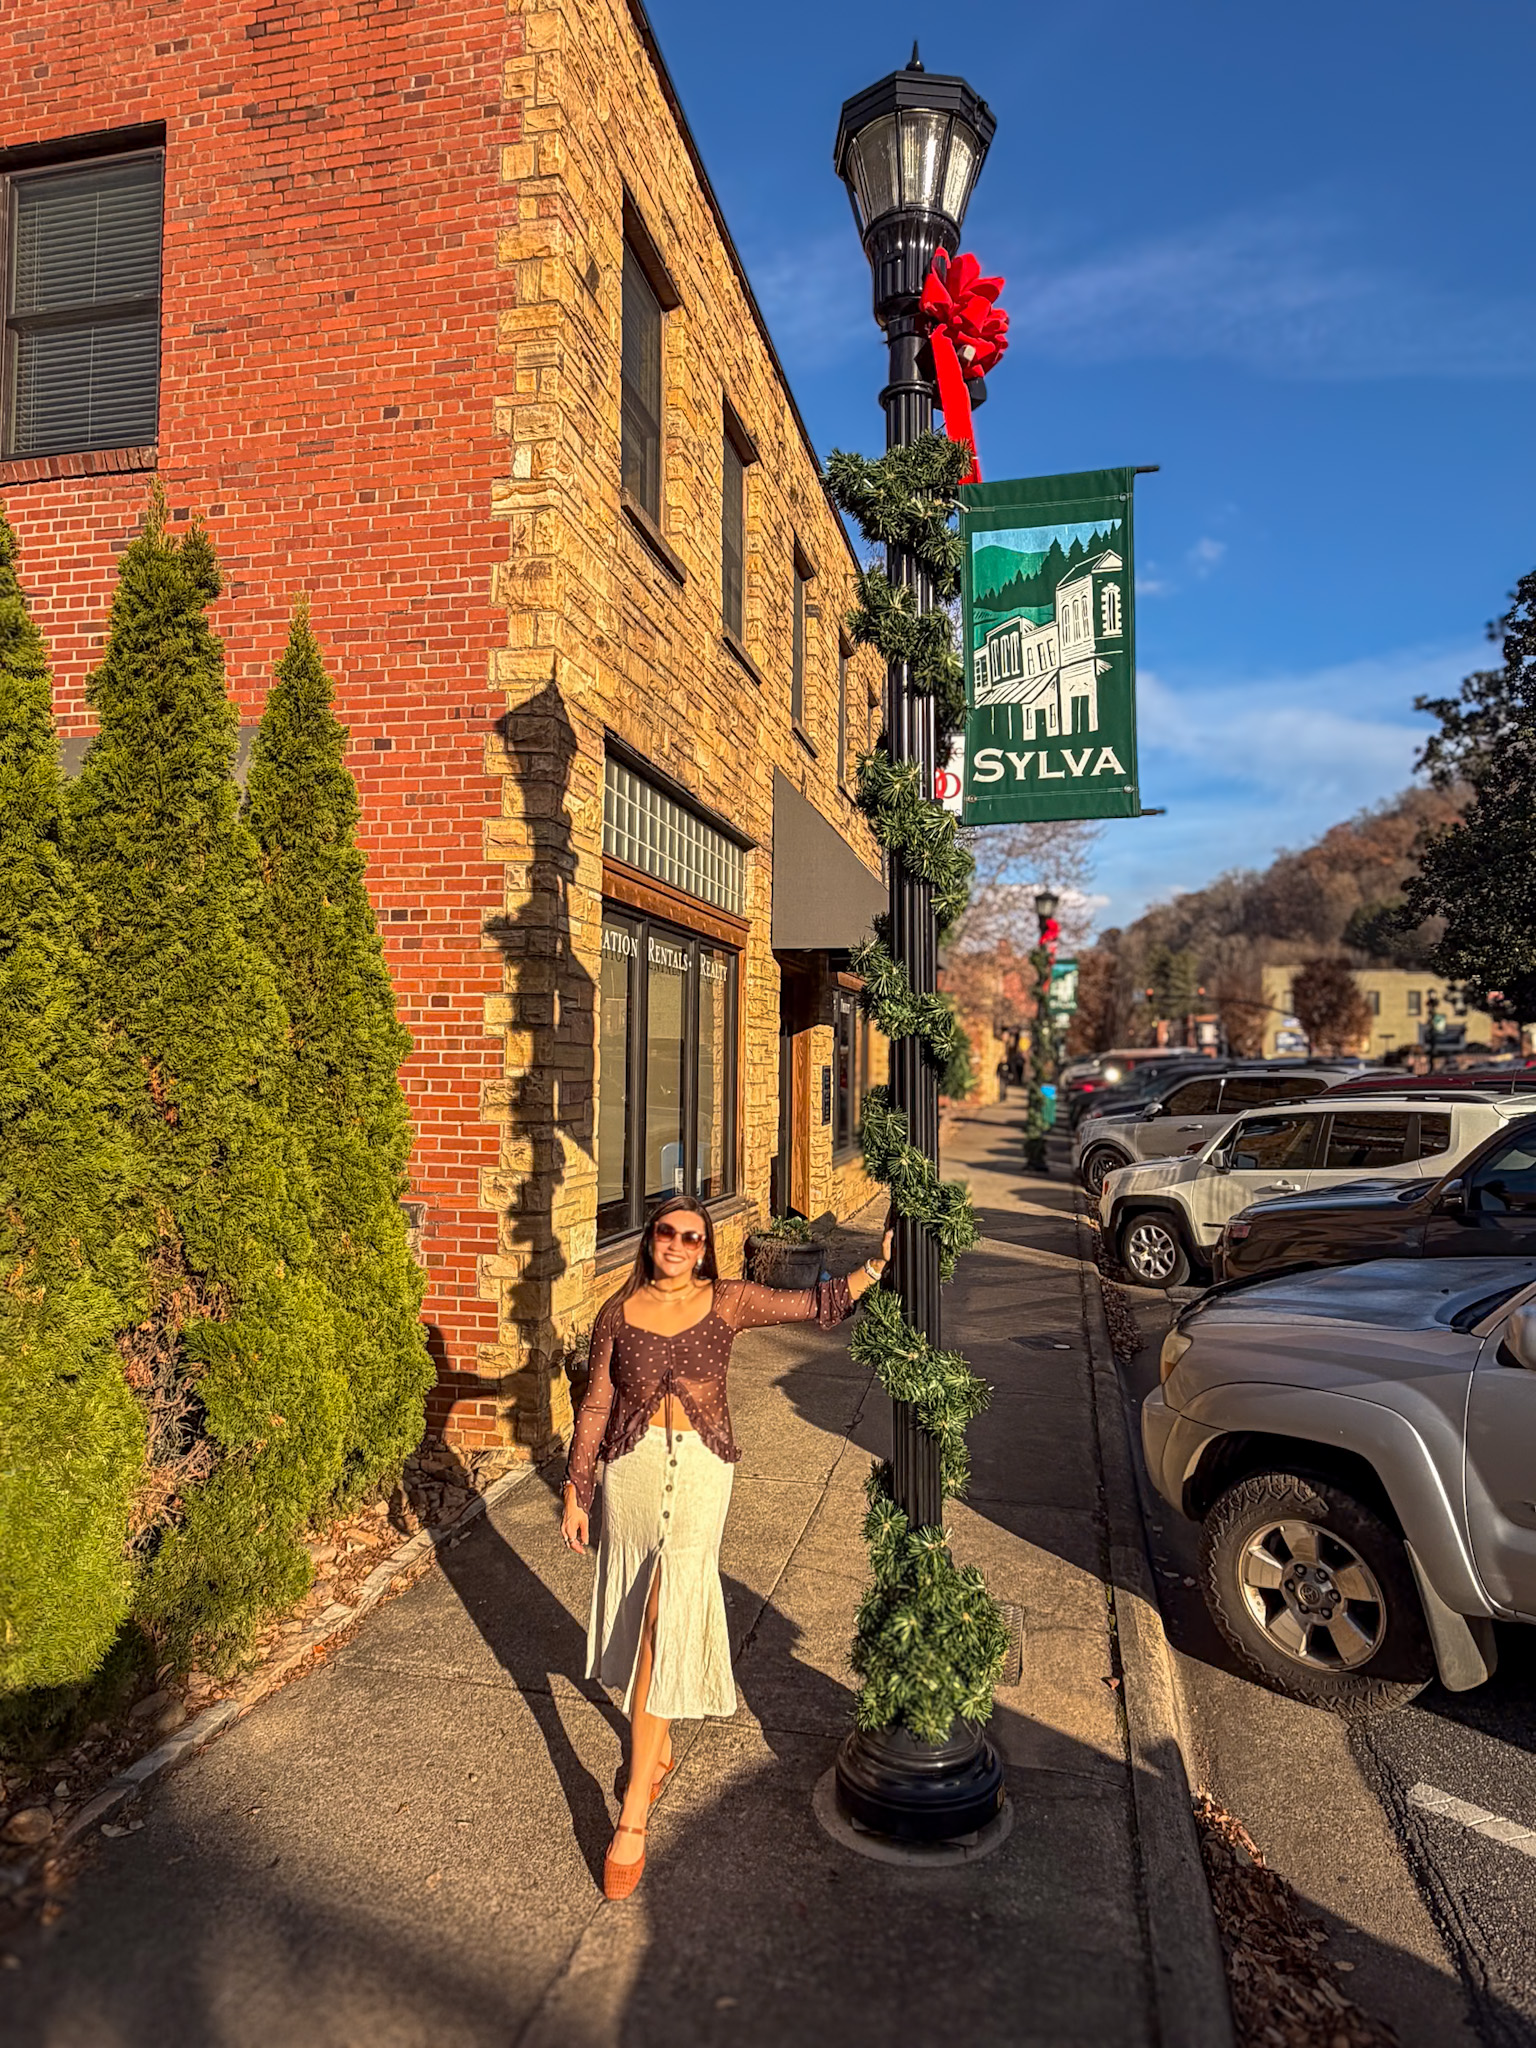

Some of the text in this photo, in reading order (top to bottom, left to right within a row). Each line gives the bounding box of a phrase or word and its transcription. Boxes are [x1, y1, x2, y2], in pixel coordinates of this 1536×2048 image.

[972, 746, 1127, 783] SYLVA
[602, 929, 728, 982] ATION RENTALS REALTY
